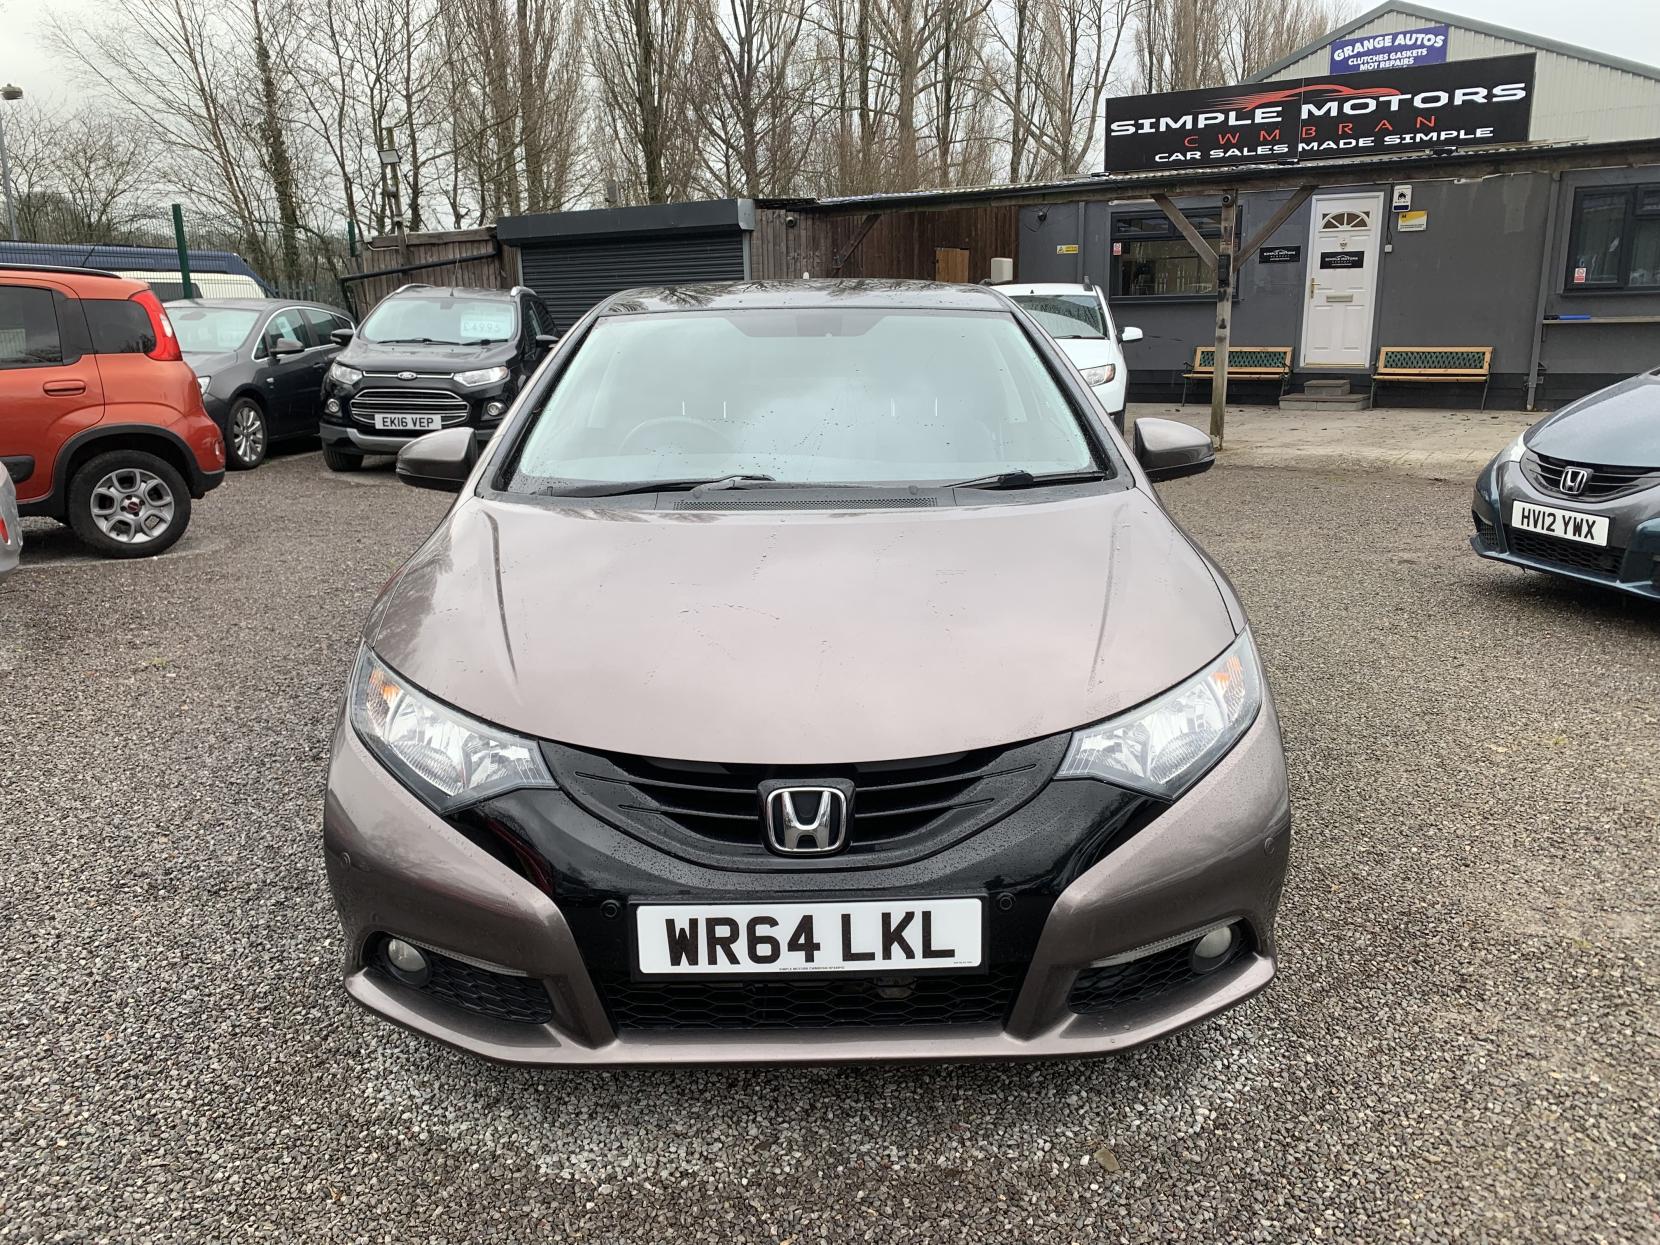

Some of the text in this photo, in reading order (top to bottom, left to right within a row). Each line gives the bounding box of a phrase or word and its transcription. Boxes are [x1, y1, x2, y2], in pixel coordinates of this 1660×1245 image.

[1333, 33, 1446, 61] GRANGE AUTOS
[1348, 48, 1428, 65] CLUTCHES GASKETS
[1359, 61, 1379, 71] MOT
[1379, 57, 1415, 68] REPAIRS
[1110, 83, 1527, 136] SIMPLE MOTORS
[1154, 127, 1495, 163] CAR SALES MADE SIMPLE
[381, 416, 434, 428] EK16 VEP
[1521, 507, 1596, 540] HV12 YWX
[665, 910, 956, 967] WR64 LKL
